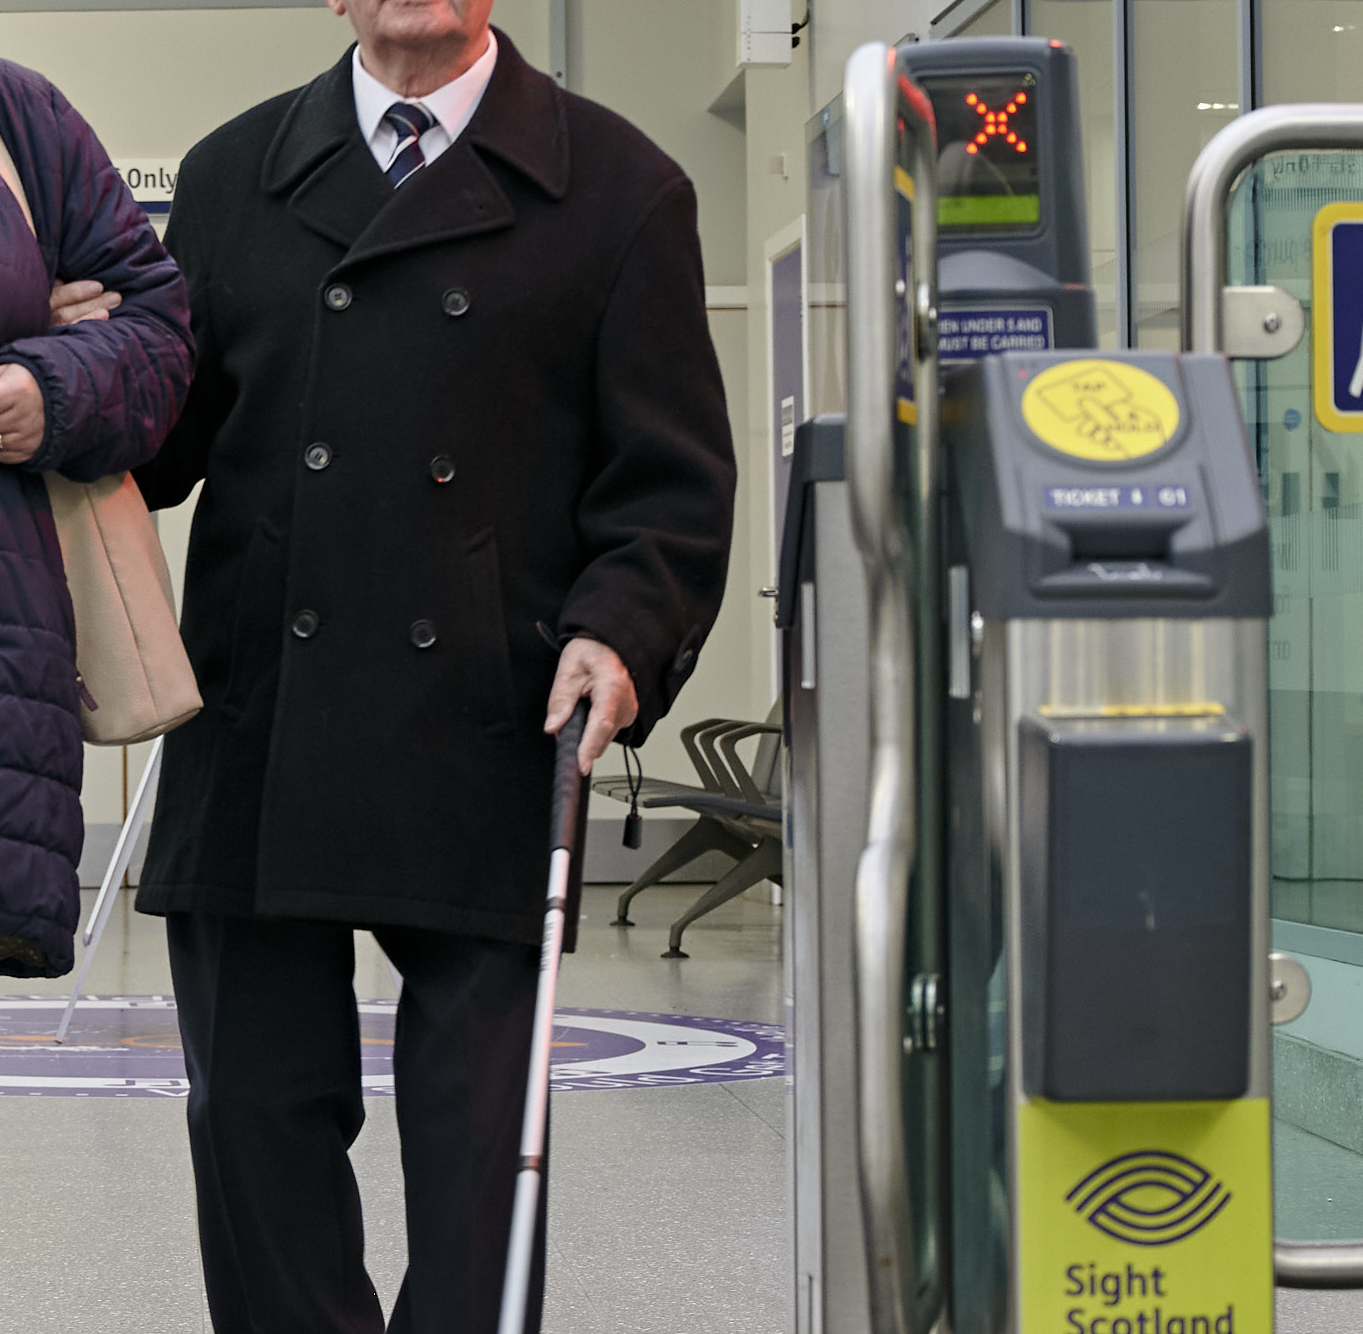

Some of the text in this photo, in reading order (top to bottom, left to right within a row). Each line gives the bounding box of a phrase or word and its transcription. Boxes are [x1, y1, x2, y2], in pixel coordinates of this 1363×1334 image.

[127, 167, 178, 194] Only
[1016, 317, 1042, 333] AND
[970, 335, 989, 350] BE
[1050, 487, 1120, 507] TICKET
[1065, 1264, 1166, 1307] Sight
